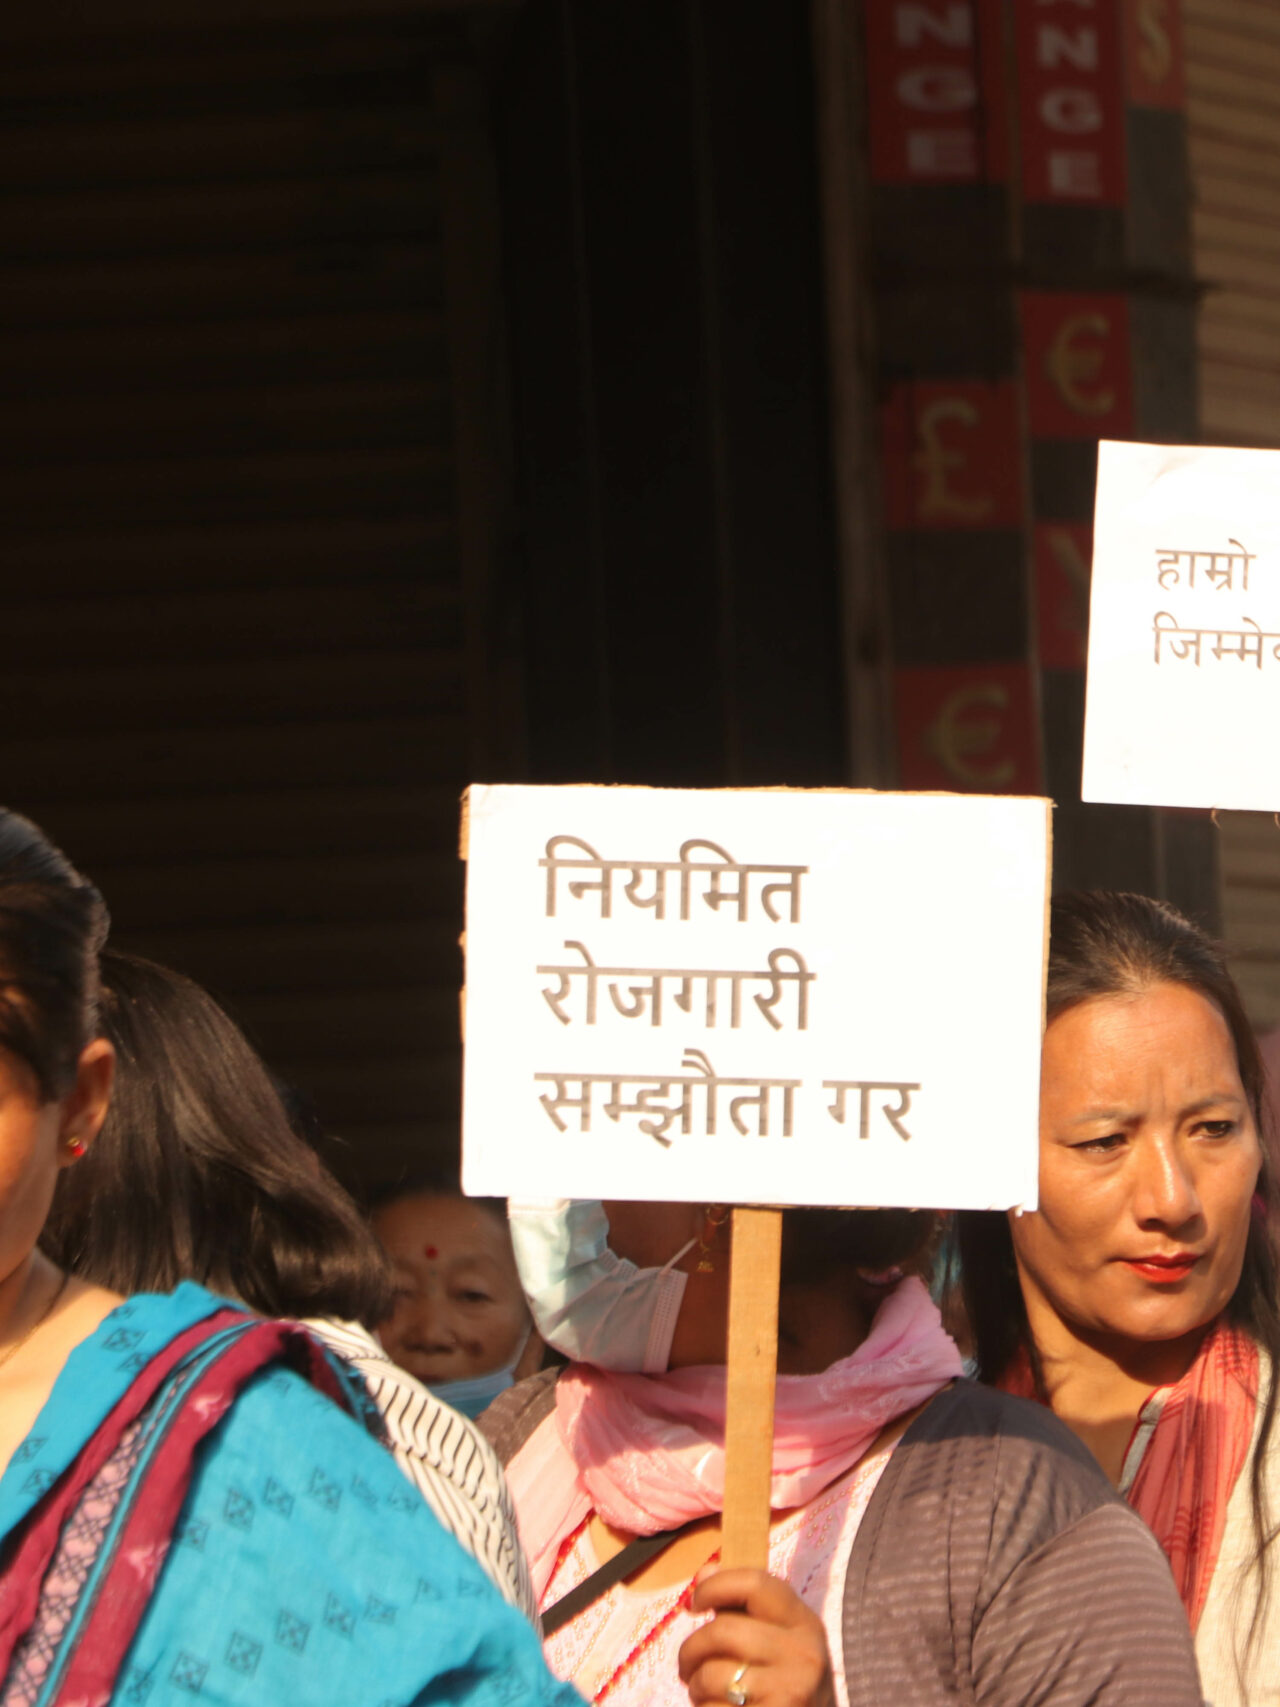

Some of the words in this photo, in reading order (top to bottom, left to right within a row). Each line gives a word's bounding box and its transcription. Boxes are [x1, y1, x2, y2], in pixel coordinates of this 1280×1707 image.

[1033, 0, 1103, 198] NGE
[912, 398, 994, 521] £
[1154, 538, 1258, 592] हाम्रो
[538, 835, 810, 924] नियमित
[536, 940, 818, 1032] रोजगारी
[534, 1048, 803, 1149] सम्झौता
[822, 1080, 922, 1142] गर
